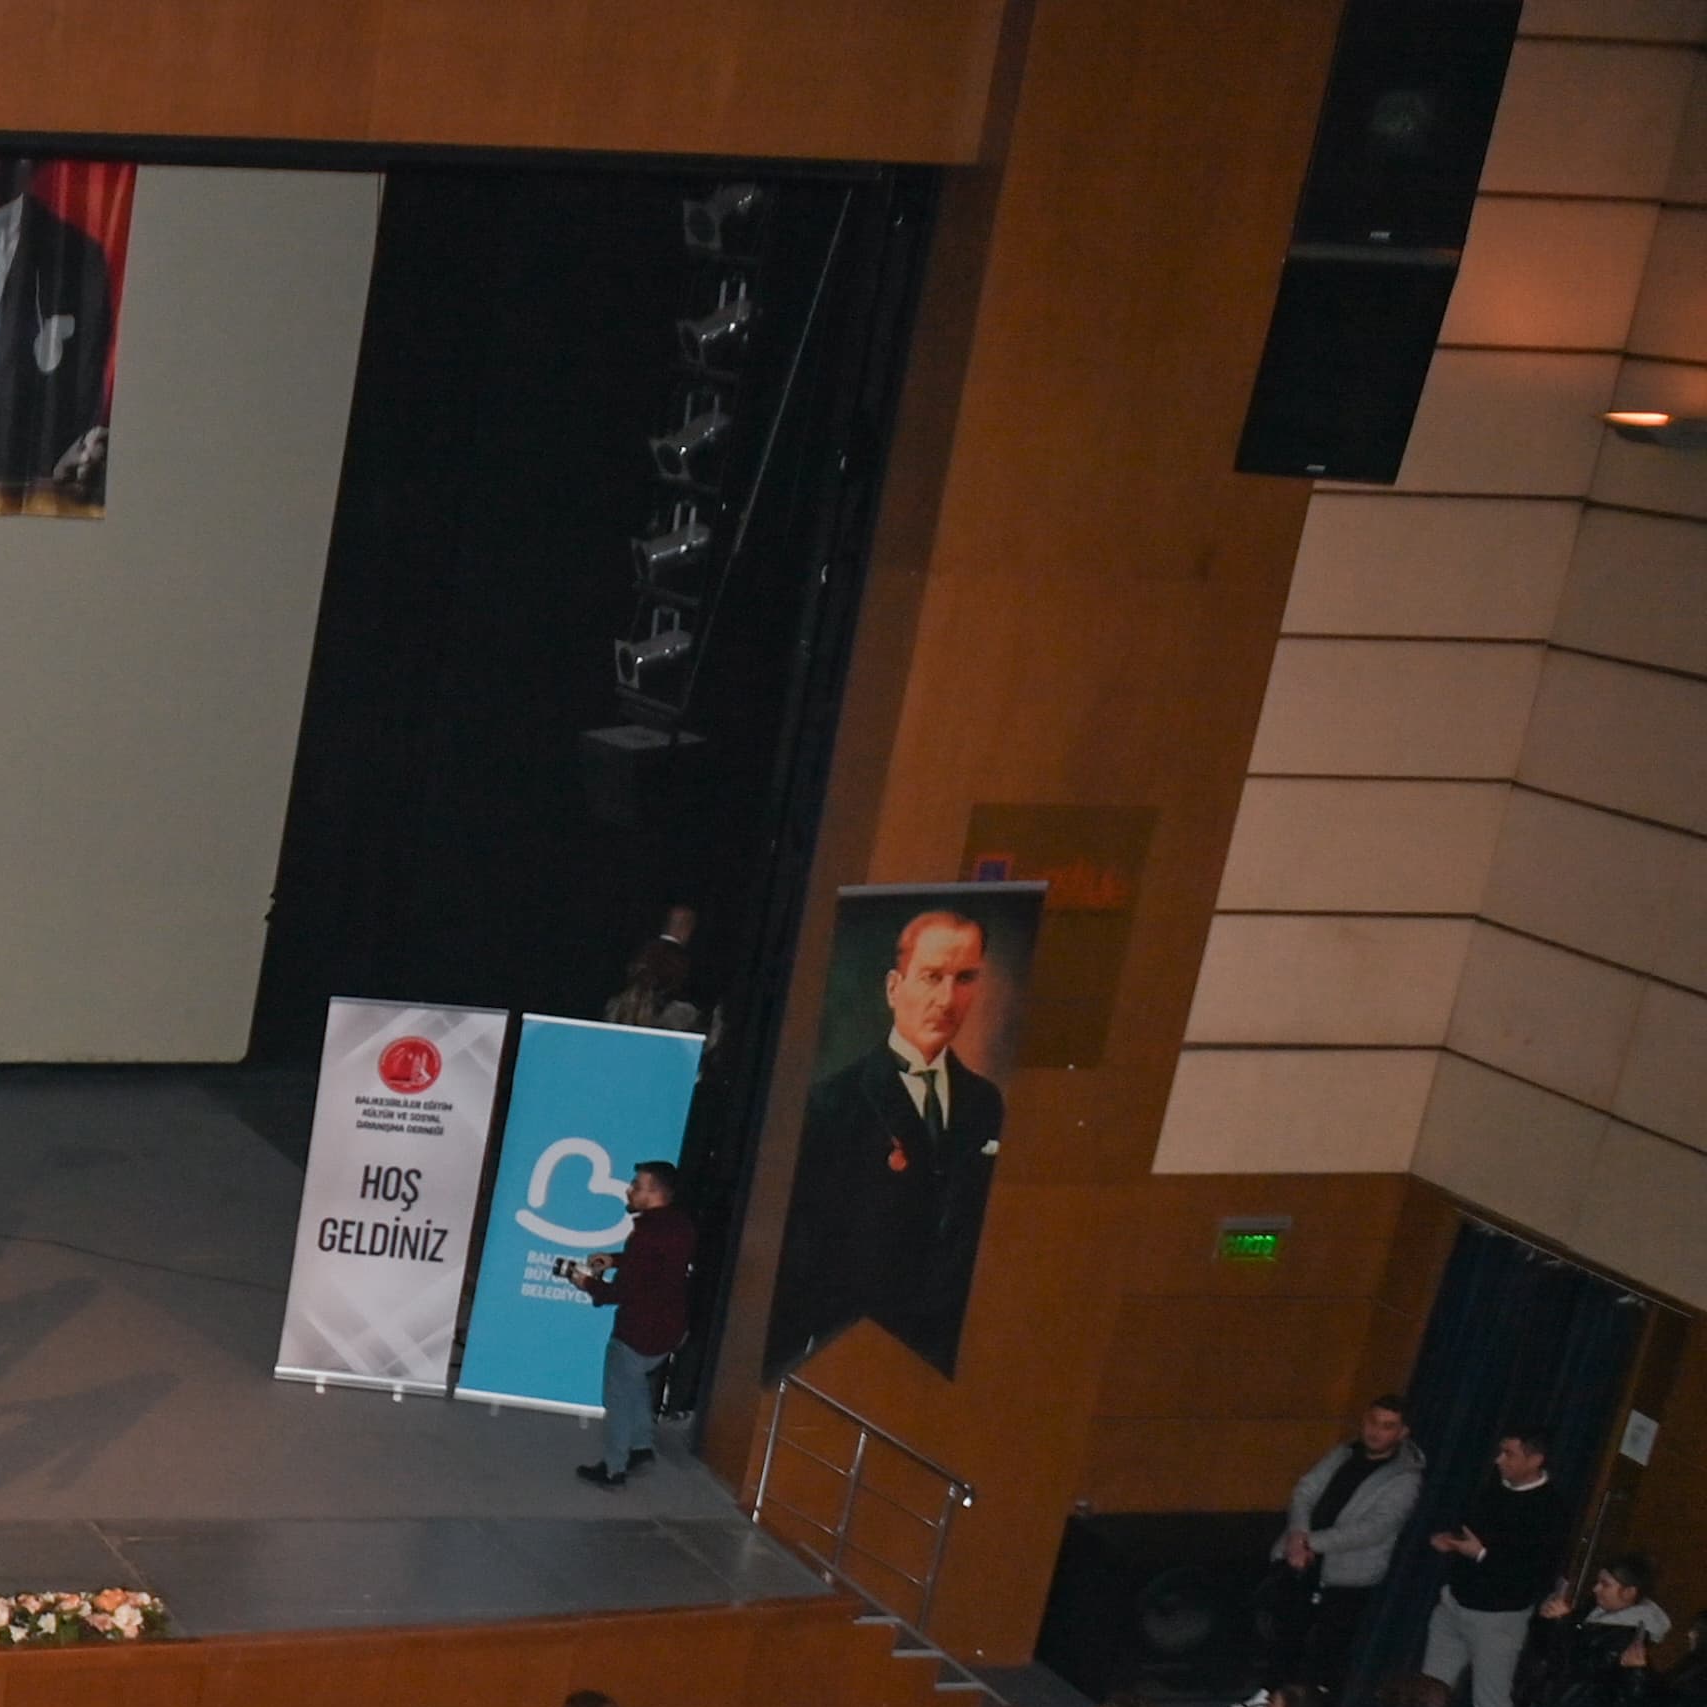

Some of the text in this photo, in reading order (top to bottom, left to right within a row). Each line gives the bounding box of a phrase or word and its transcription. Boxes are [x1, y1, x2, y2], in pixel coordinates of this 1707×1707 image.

[359, 1164, 423, 1213] HOŞ
[317, 1216, 449, 1263] GELDİNİZ
[521, 1281, 594, 1305] BELEDİYES
